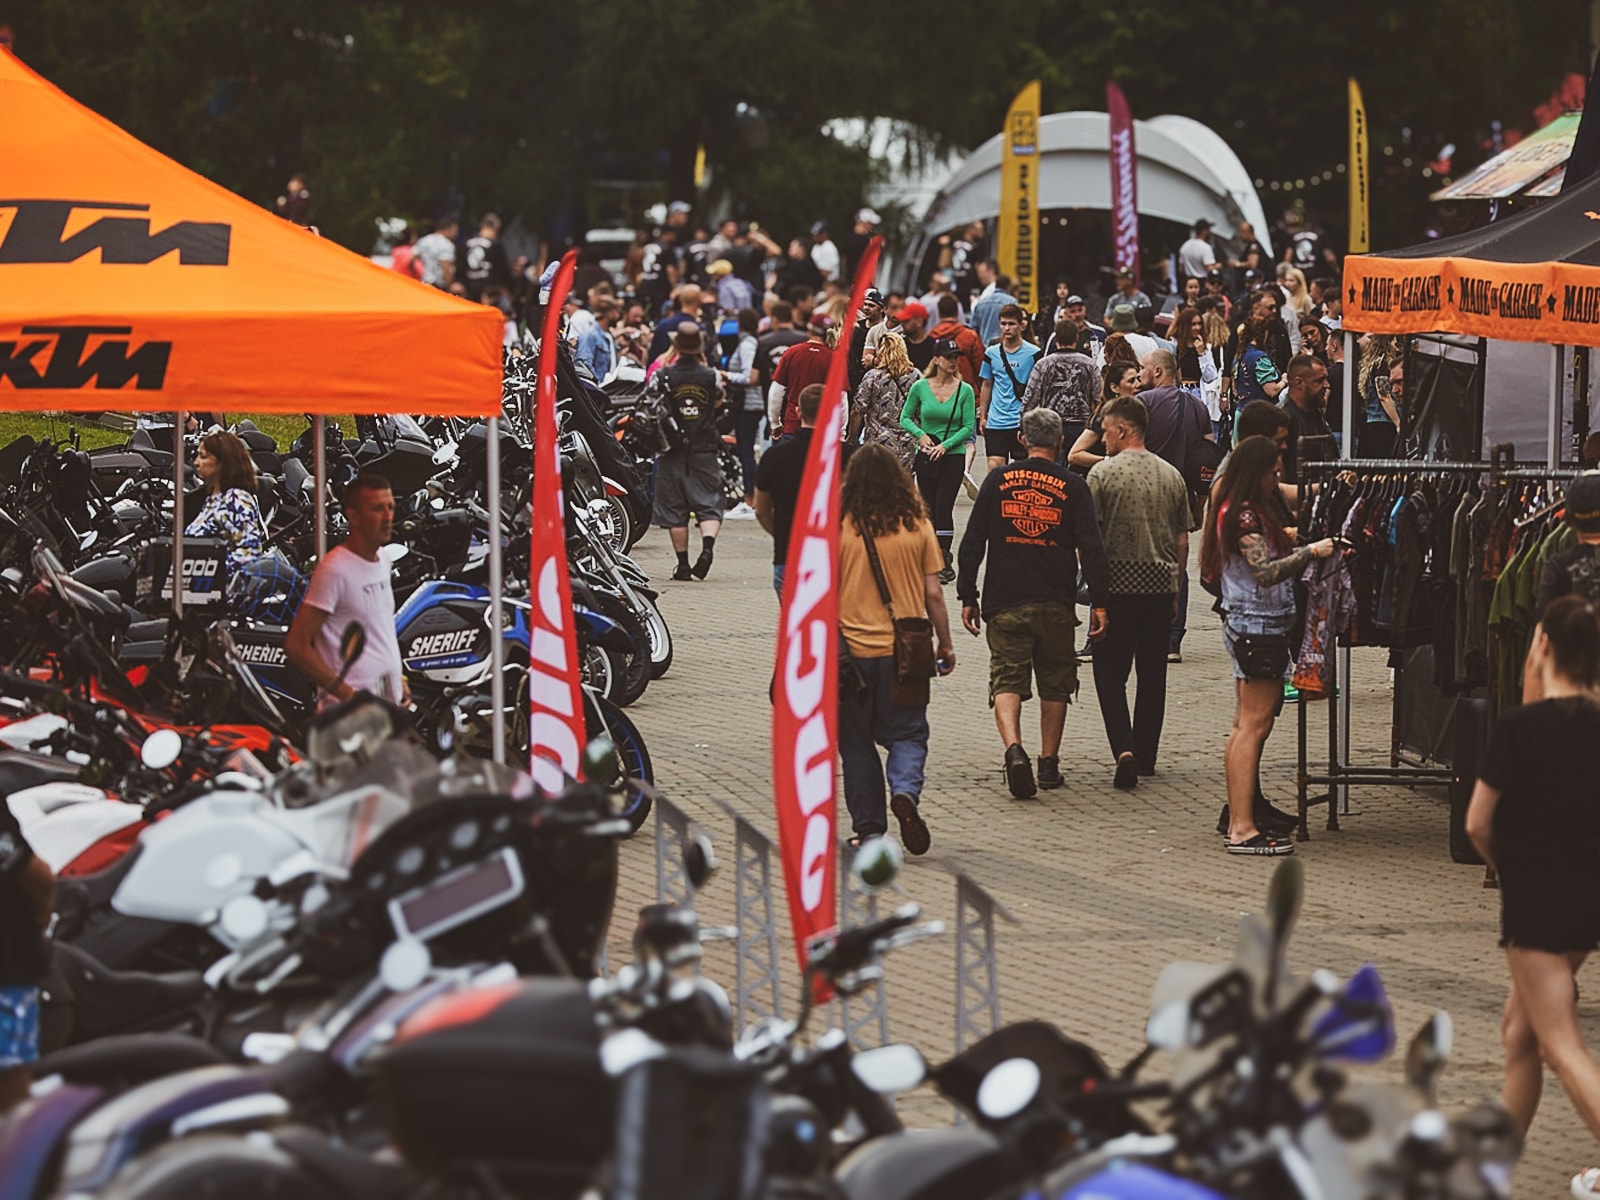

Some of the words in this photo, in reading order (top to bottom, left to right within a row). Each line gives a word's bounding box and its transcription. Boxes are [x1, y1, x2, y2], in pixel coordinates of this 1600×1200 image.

[0, 199, 232, 266] TM
[1361, 276, 1394, 312] MADE
[1400, 275, 1442, 312] GARAGE
[1458, 276, 1492, 316] MADE
[1499, 282, 1544, 320] GARAGE
[1562, 284, 1600, 324] MADE
[0, 325, 173, 390] KTM
[999, 480, 1028, 491] HARLEY
[1003, 470, 1066, 489] WISCONSIN
[1018, 493, 1047, 505] MOTOR
[408, 628, 480, 657] SHERIFF
